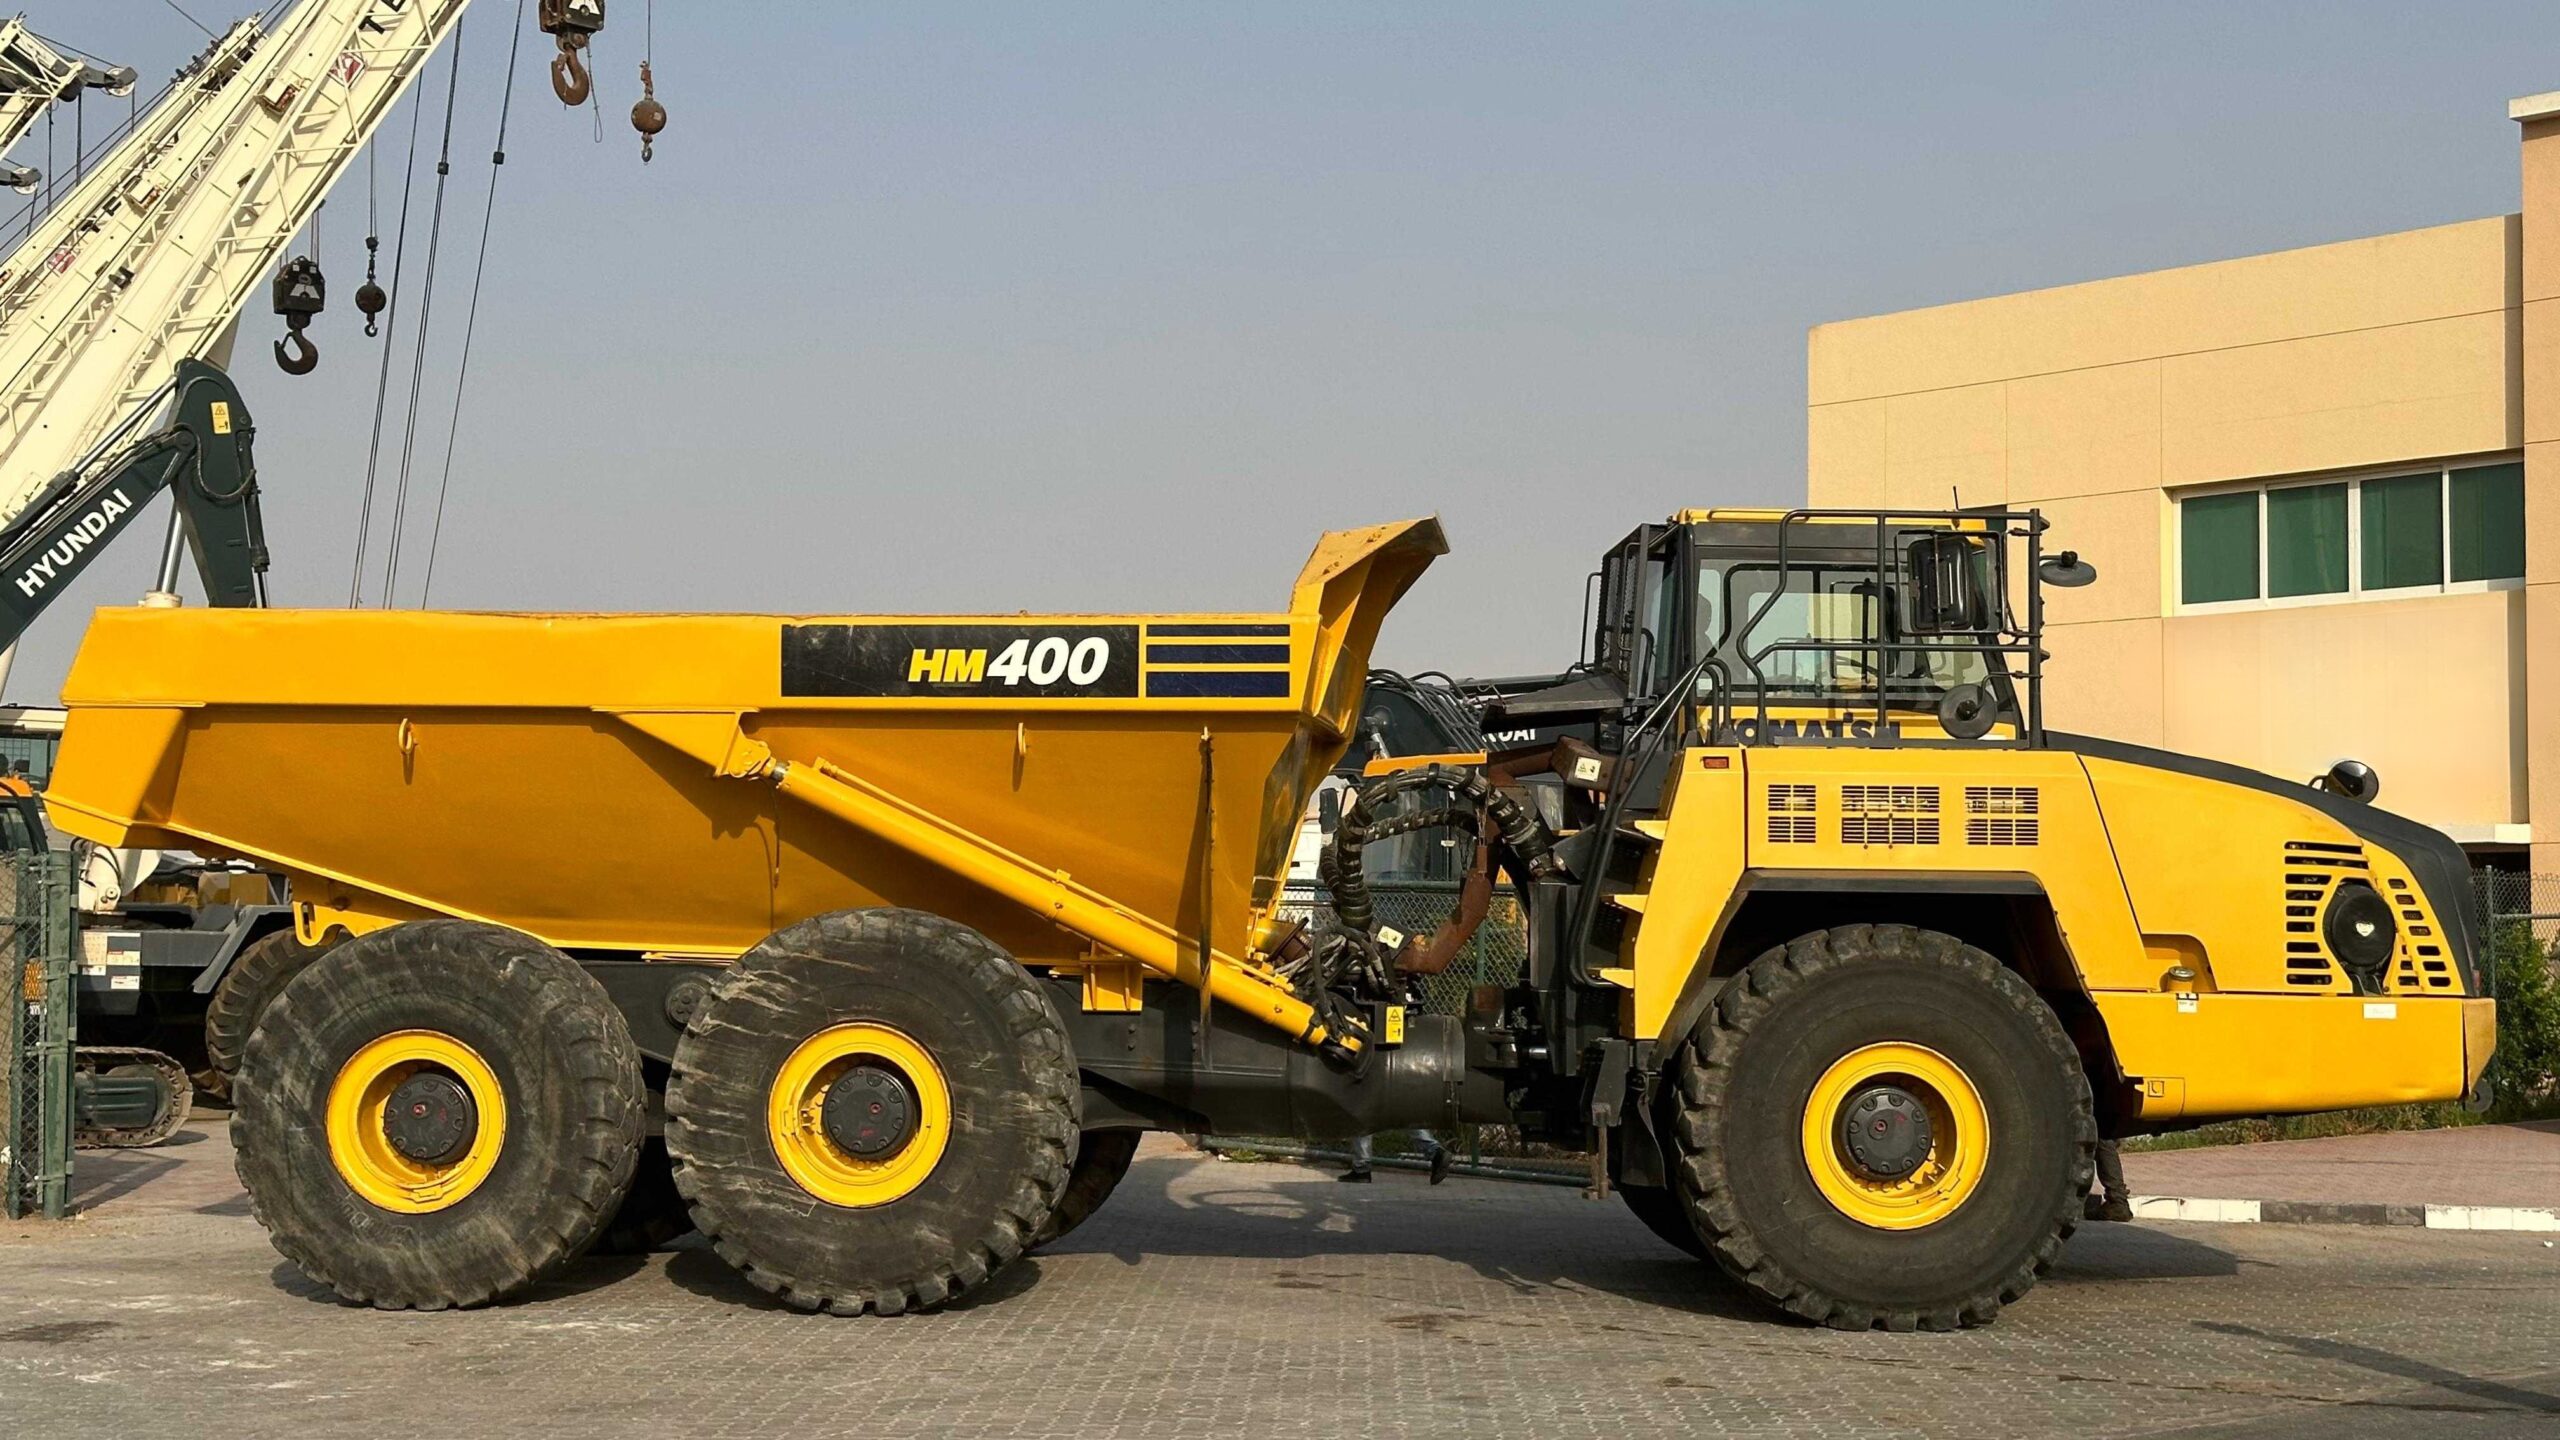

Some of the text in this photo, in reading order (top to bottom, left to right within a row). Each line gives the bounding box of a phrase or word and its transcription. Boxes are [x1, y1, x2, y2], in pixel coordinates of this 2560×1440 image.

[15, 488, 133, 598] HYUNDAI
[908, 636, 1110, 686] HM400
[1707, 712, 1901, 748] OMATS
